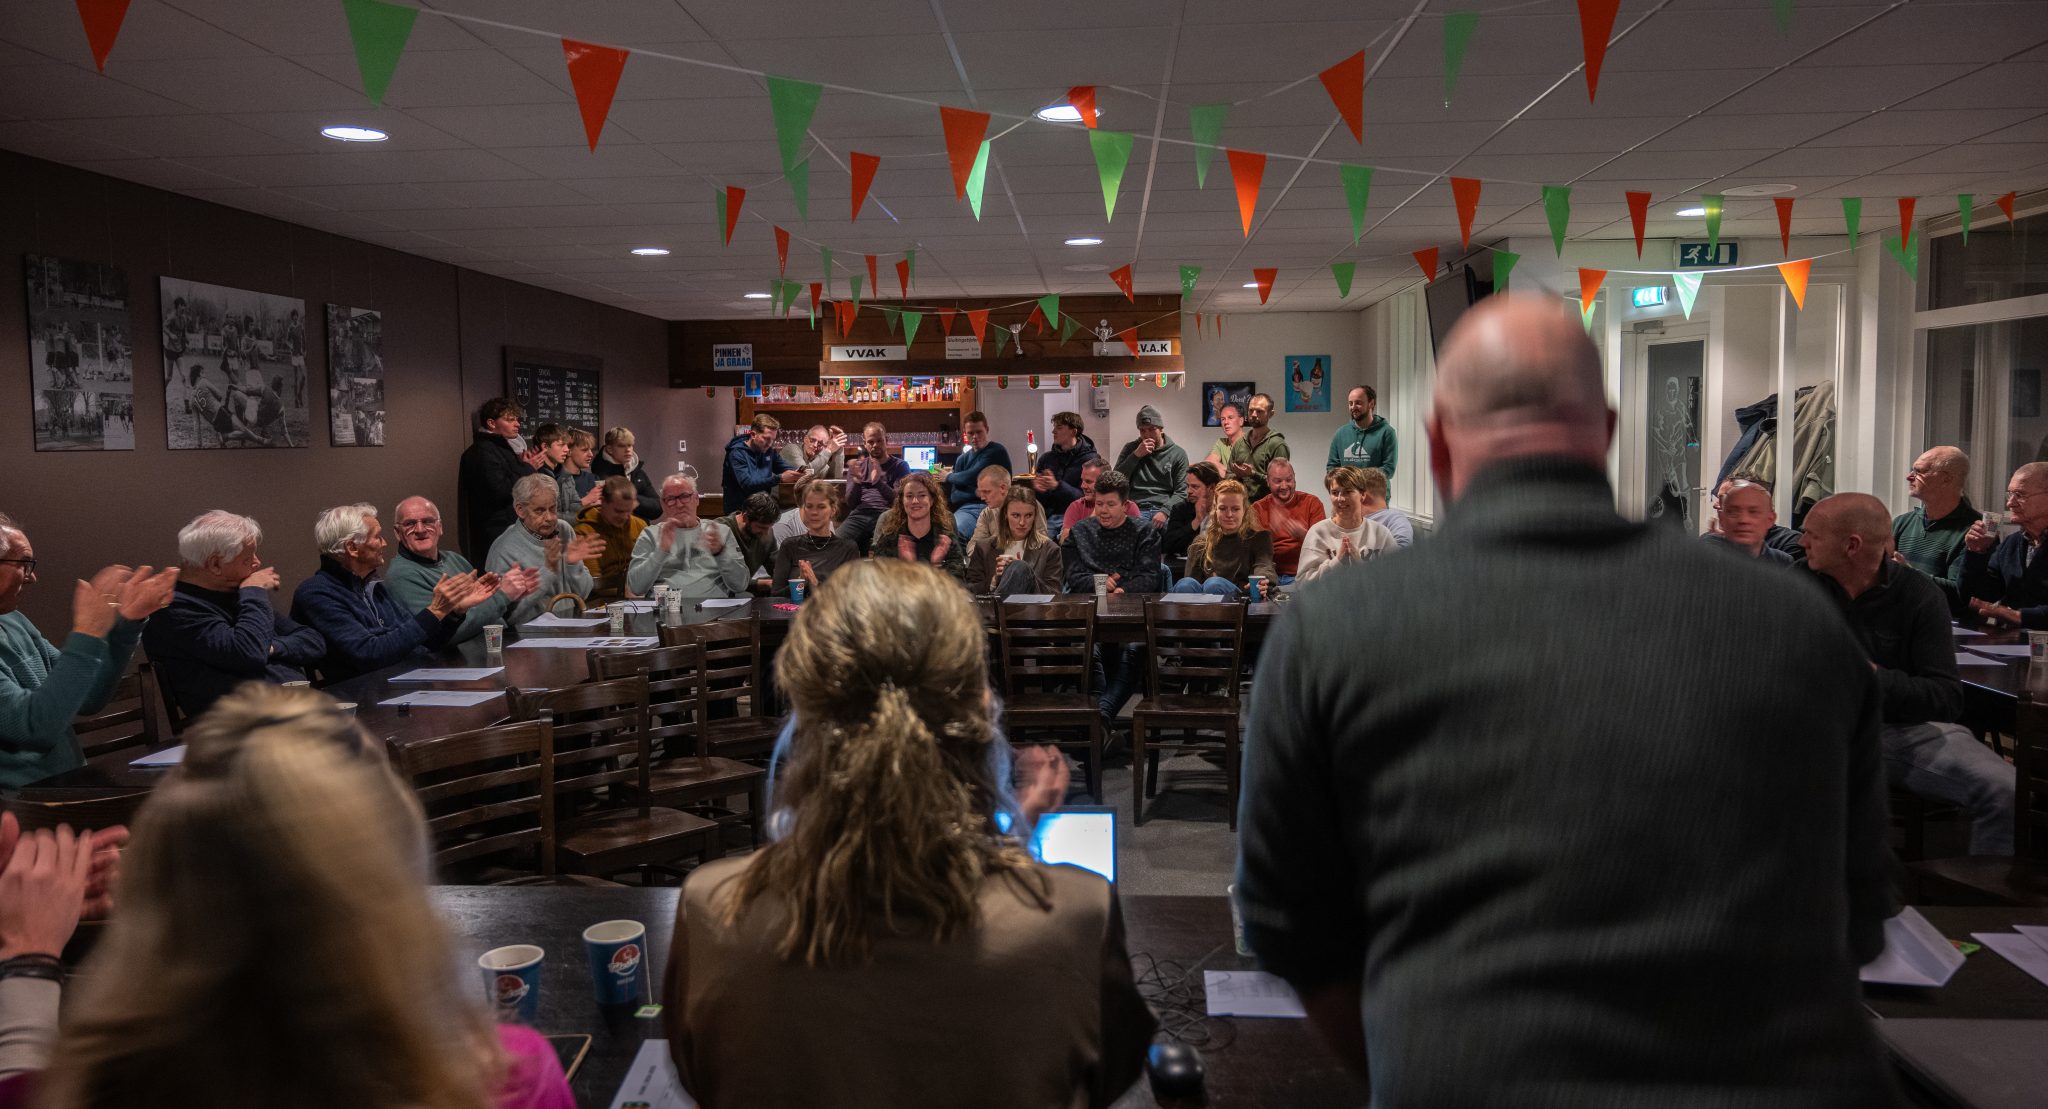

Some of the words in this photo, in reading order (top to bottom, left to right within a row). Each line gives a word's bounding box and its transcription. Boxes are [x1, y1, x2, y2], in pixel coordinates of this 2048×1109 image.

[715, 348, 742, 358] PINNEN
[1137, 343, 1169, 353] .V.A.K
[845, 348, 887, 359] VVAK
[715, 357, 725, 368] JA
[726, 357, 752, 367] GRAAG
